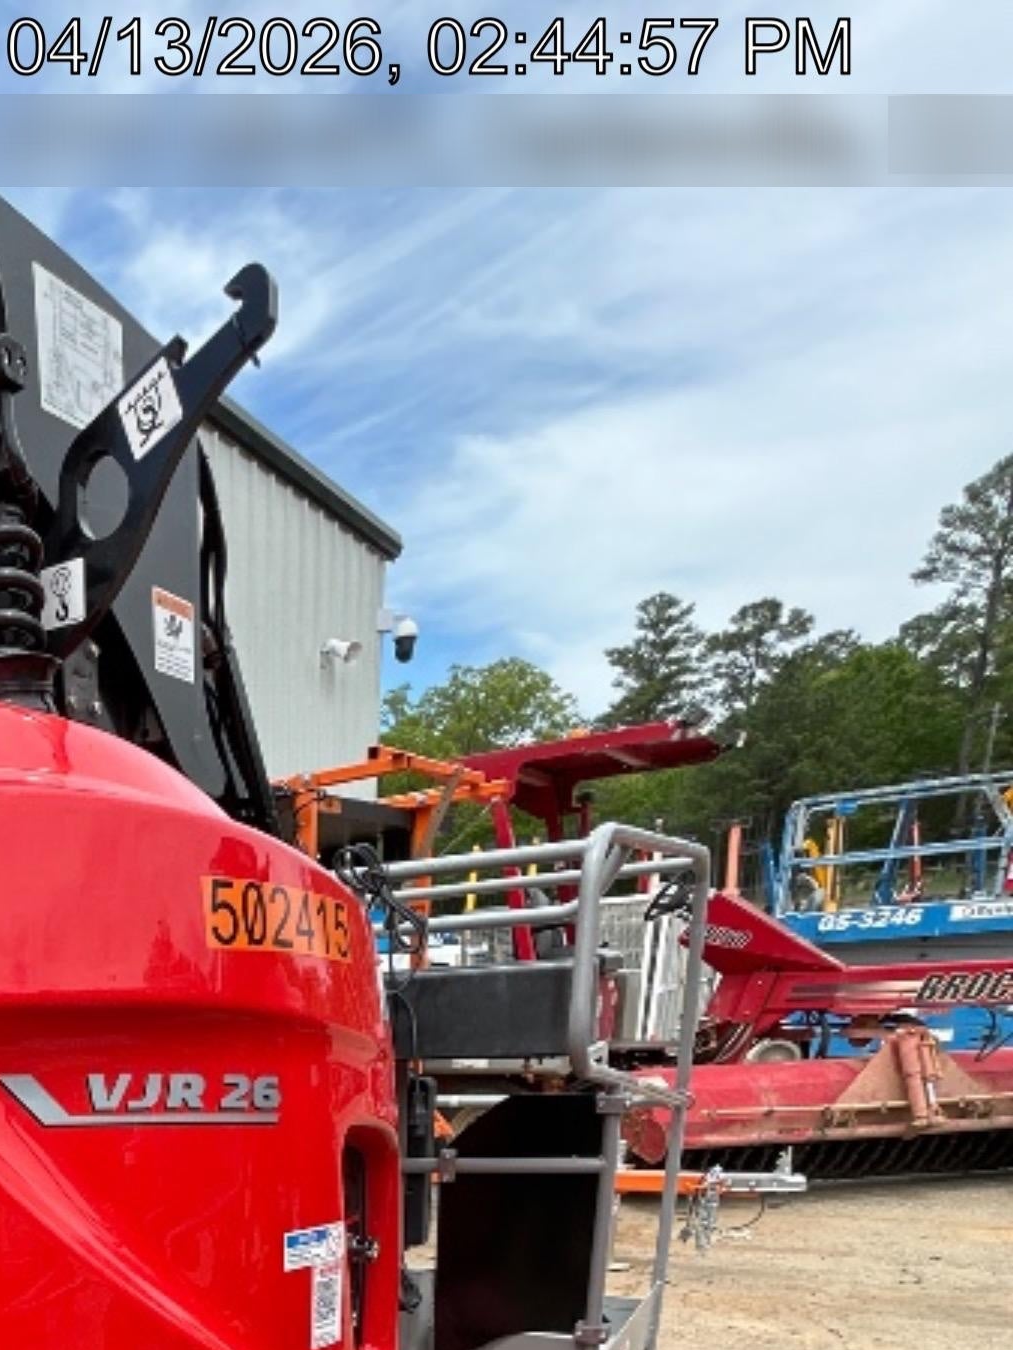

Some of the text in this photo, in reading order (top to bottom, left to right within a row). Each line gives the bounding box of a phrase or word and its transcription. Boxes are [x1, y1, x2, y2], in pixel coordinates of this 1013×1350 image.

[210, 879, 349, 958] 502415
[86, 1073, 282, 1112] VJR 26
